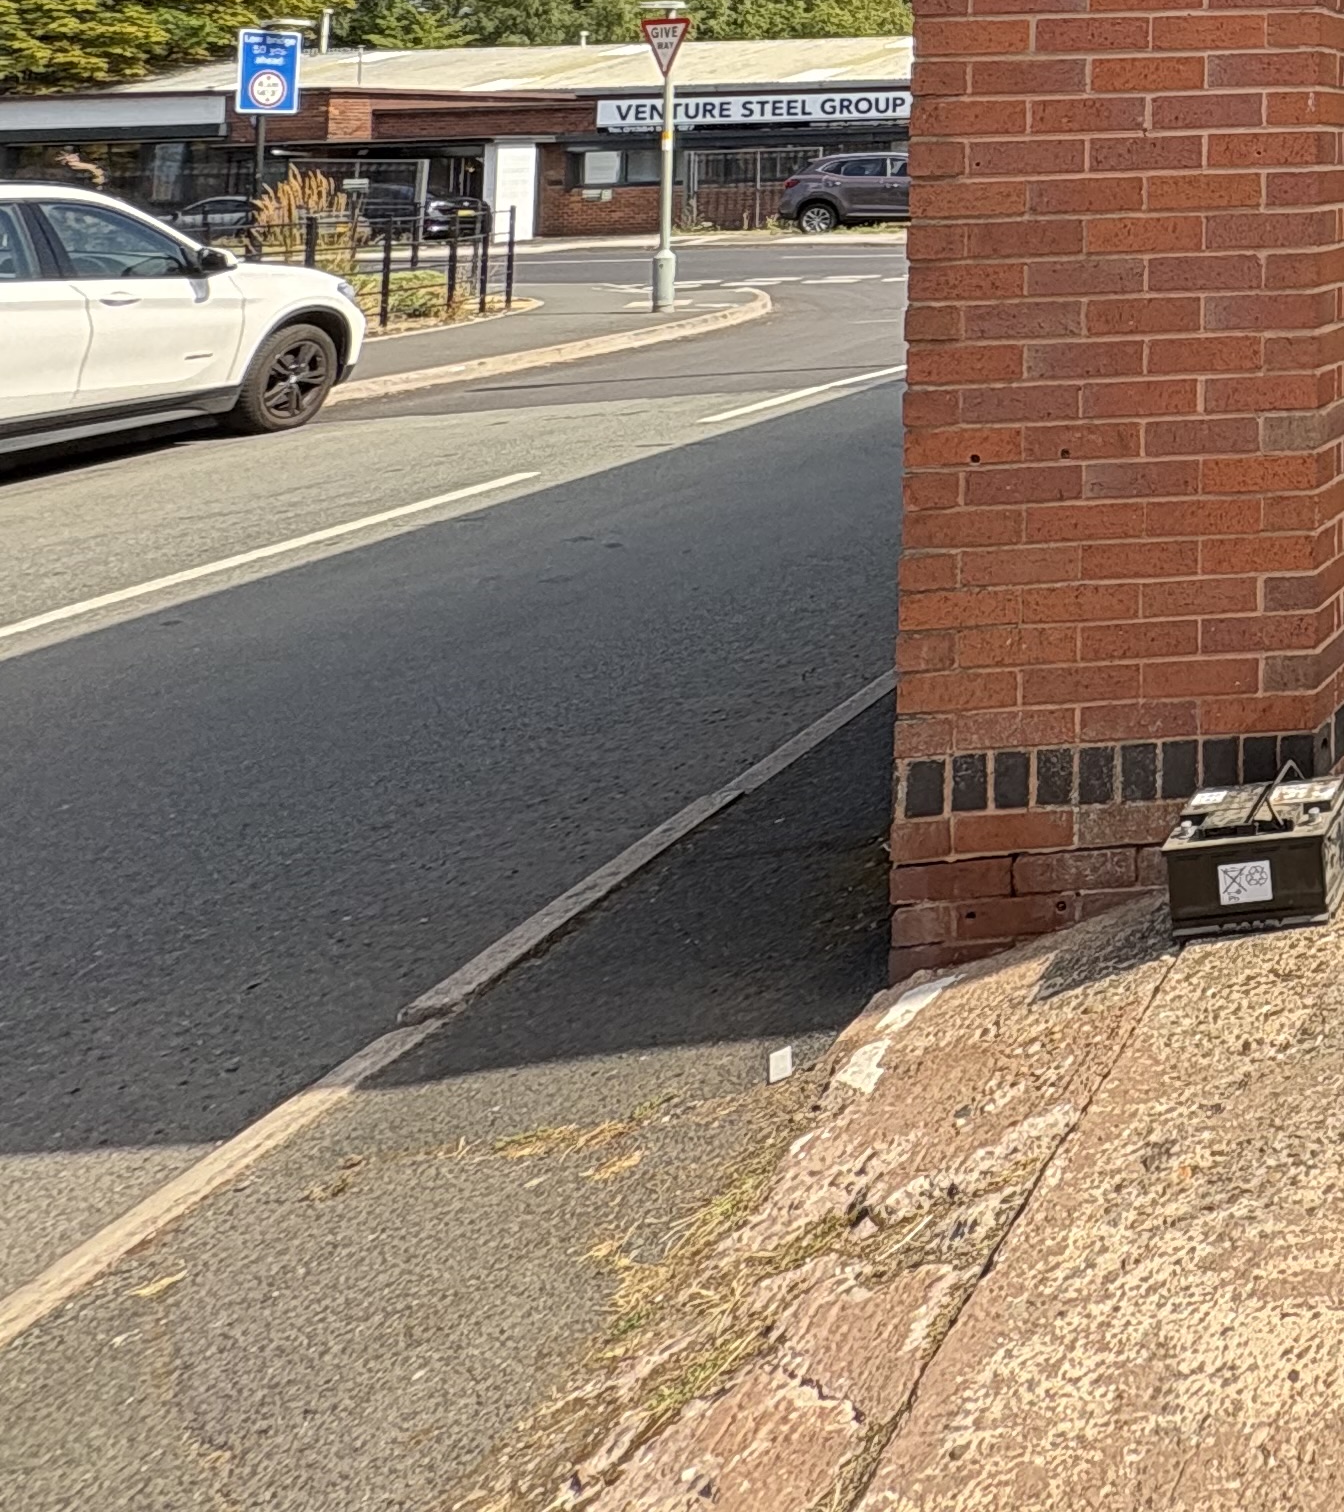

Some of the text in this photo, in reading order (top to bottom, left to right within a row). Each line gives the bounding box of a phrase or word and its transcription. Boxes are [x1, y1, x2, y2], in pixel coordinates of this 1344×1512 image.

[650, 25, 679, 39] GIVE
[616, 96, 906, 121] VENTURE STEEL GROUP
